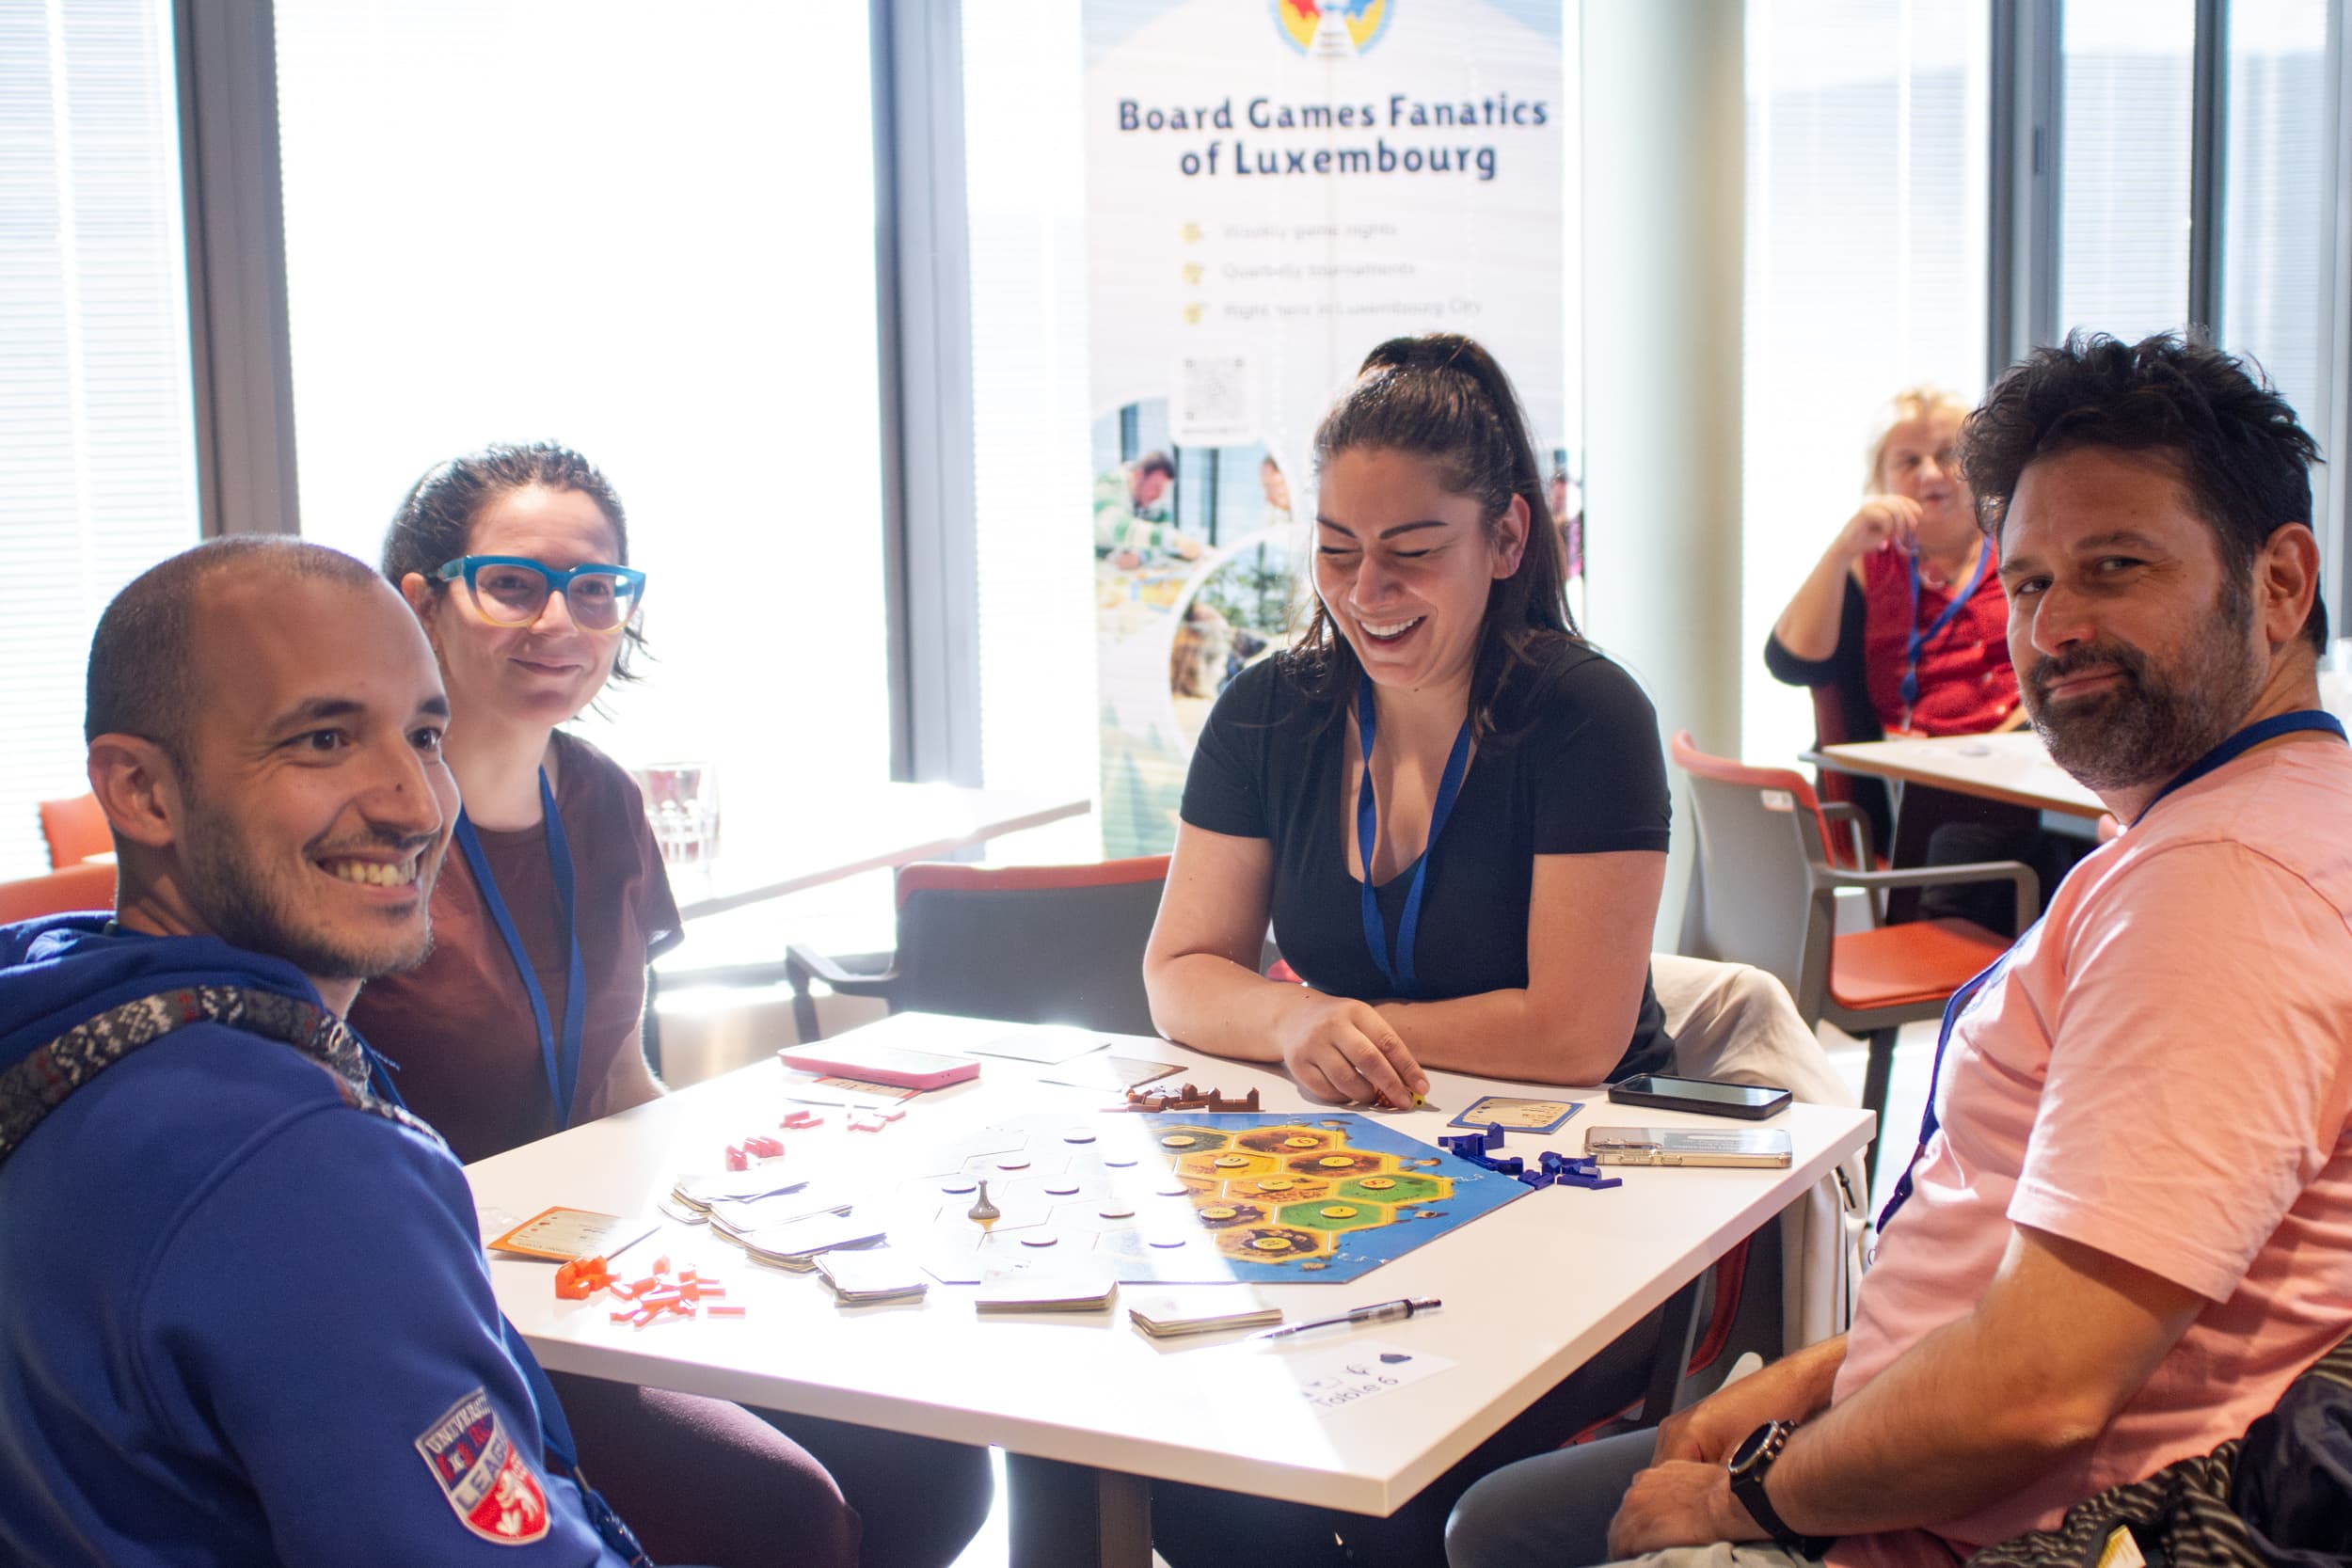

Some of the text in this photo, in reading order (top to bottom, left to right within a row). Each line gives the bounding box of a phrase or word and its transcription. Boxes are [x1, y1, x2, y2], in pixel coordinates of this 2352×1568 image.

[1118, 92, 1549, 131] Board Games Fanatics
[1180, 138, 1498, 182] of Luxembourg
